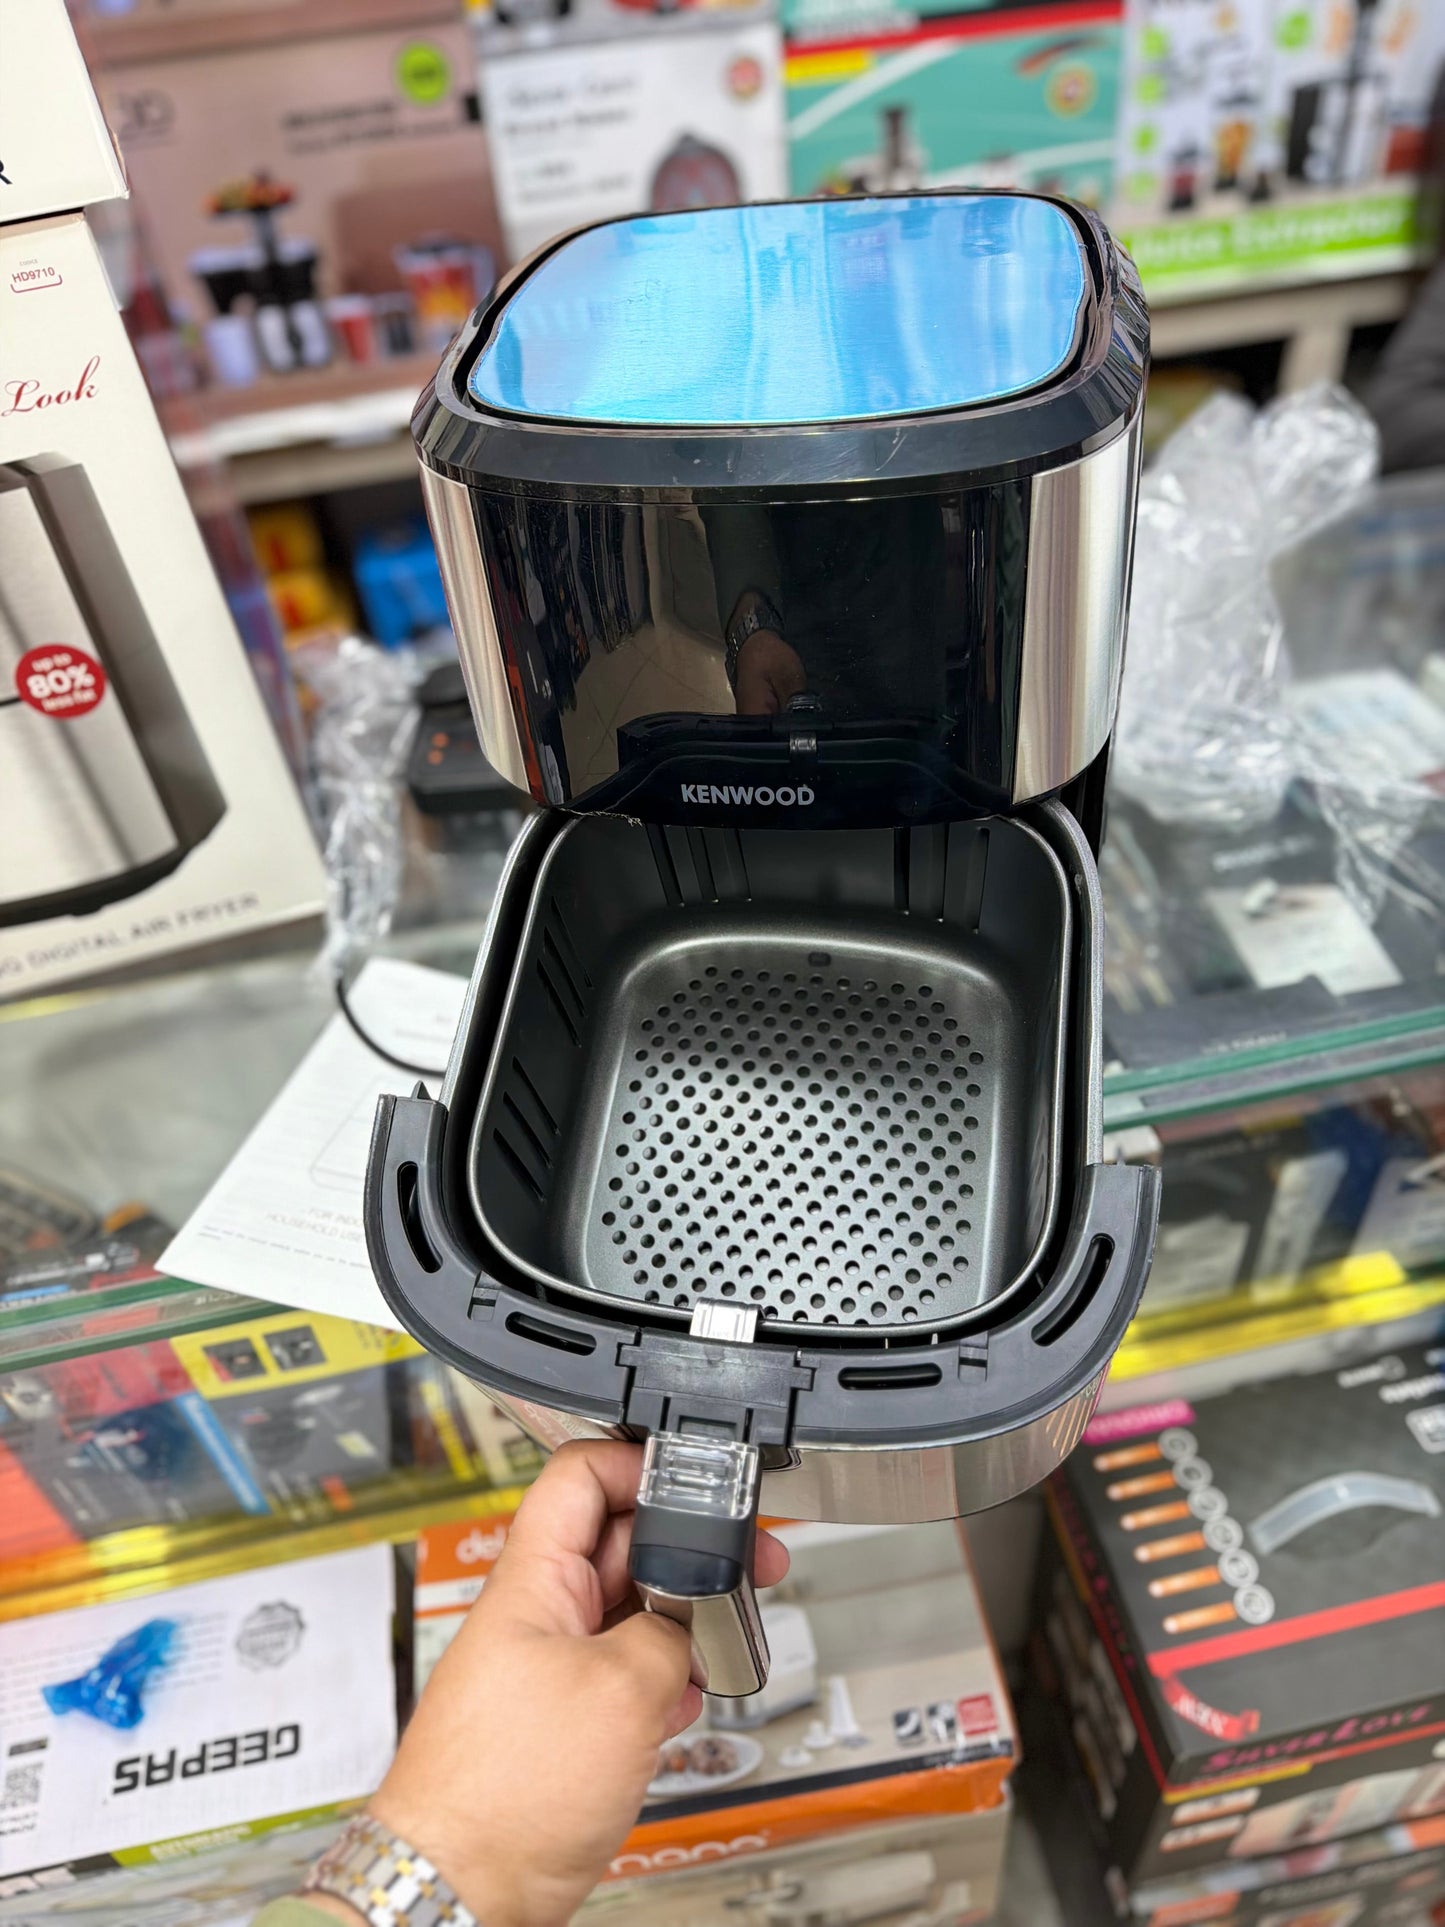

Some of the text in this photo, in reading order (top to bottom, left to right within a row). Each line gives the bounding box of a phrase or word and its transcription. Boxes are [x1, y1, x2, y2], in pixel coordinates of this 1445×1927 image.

[12, 266, 56, 284] HD9710
[1, 354, 100, 417] Look
[26, 662, 96, 699] 80%
[680, 784, 815, 806] KENWOOD
[113, 1723, 300, 1795] GEEPAS
